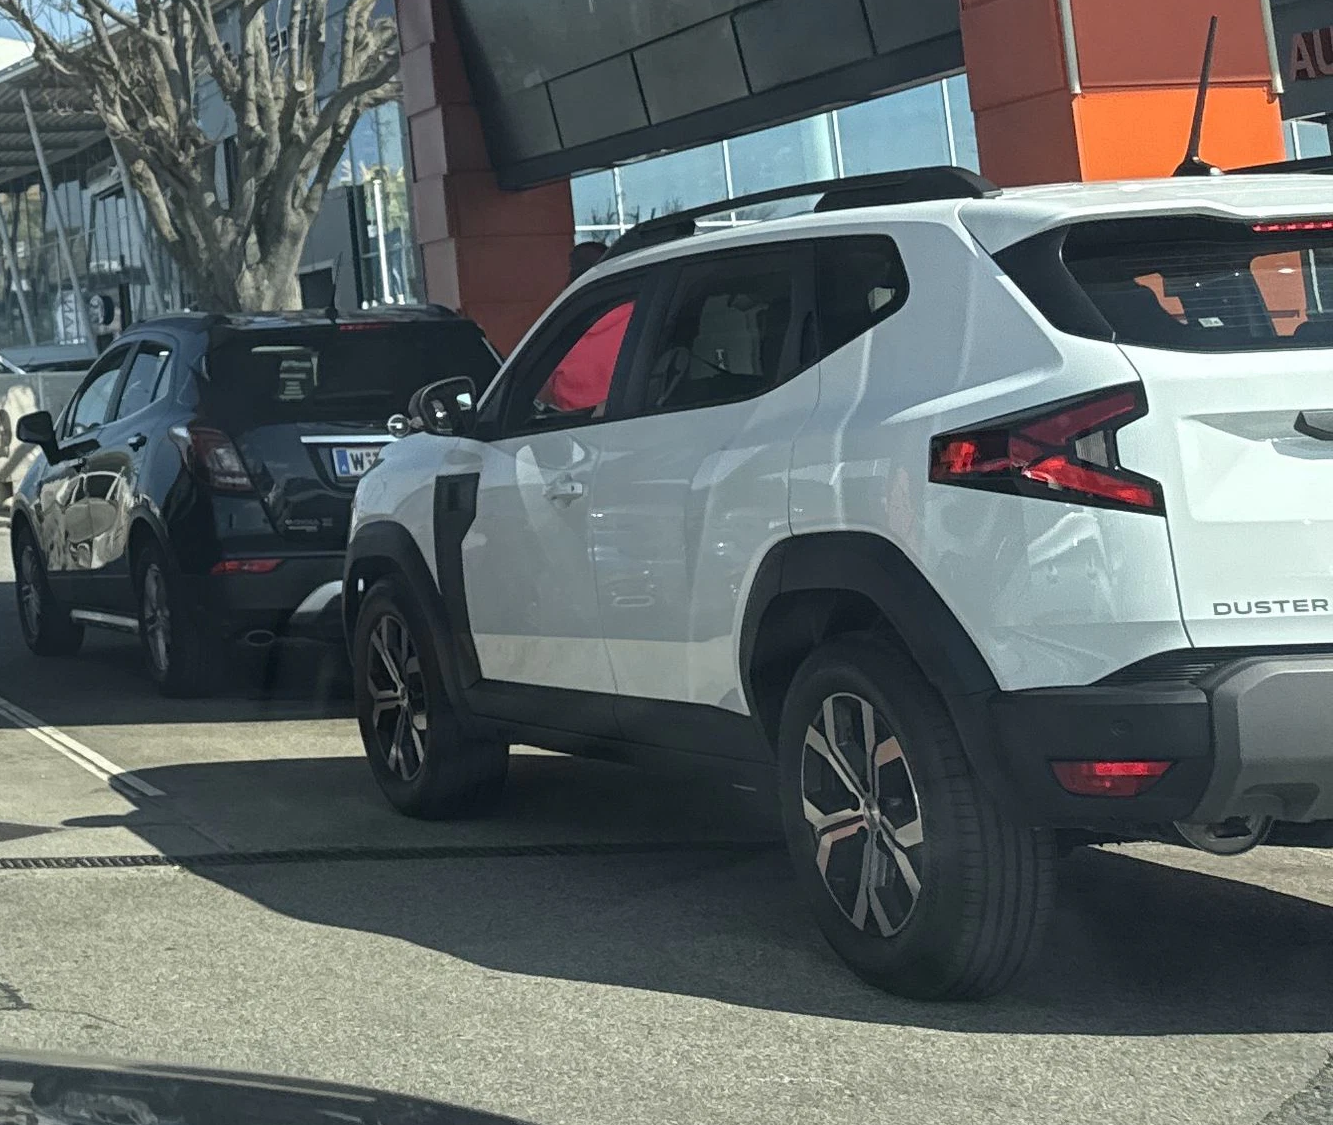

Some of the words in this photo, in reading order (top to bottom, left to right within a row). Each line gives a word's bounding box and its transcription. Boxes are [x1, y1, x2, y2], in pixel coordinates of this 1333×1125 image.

[1290, 26, 1333, 81] AU
[350, 452, 364, 471] W
[1213, 598, 1329, 616] DUSTER
